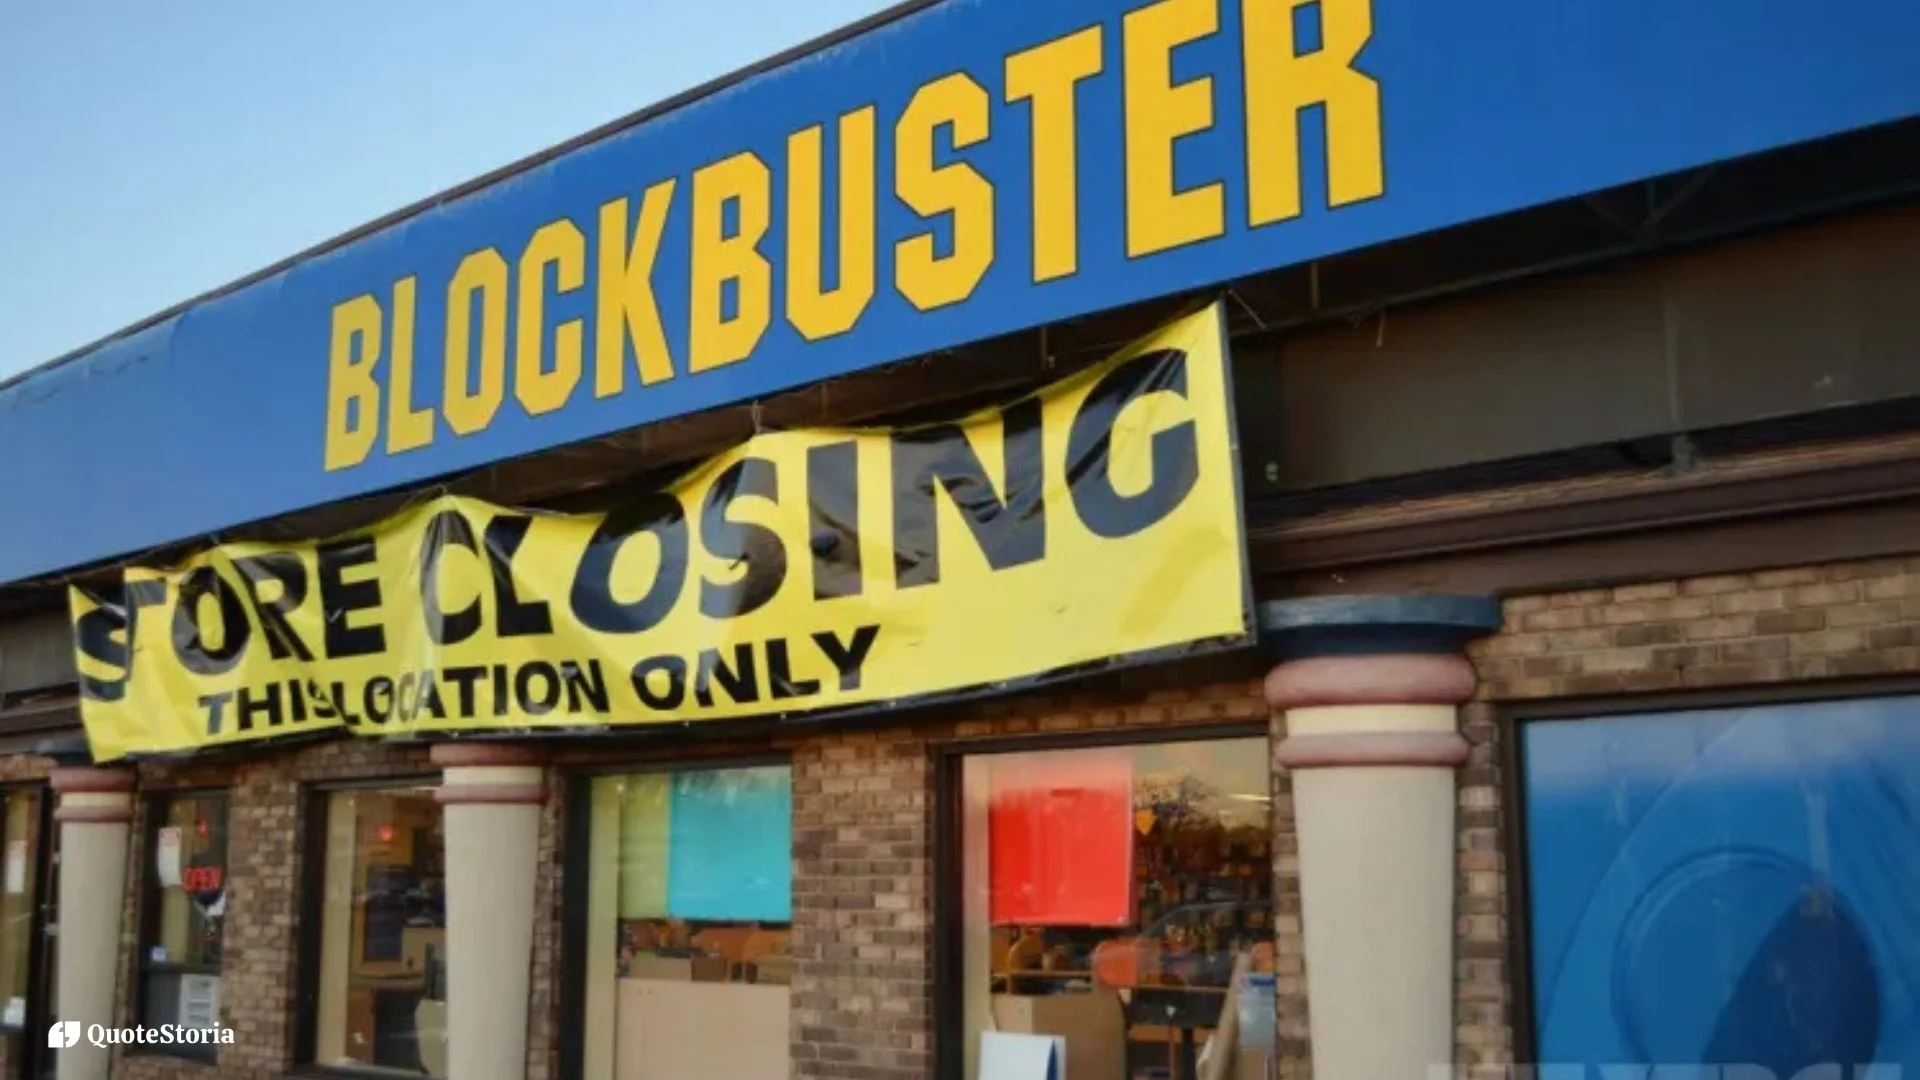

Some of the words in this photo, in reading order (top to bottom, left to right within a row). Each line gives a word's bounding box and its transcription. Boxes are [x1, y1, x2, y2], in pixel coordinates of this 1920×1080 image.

[323, 0, 1384, 472] BLOCKBUSTER
[75, 536, 388, 703] STORE
[419, 347, 1200, 645] CLOSING
[198, 679, 336, 736] THIS
[331, 659, 610, 726] LOCATION
[631, 625, 881, 711] ONLY
[183, 866, 222, 894] OPEN
